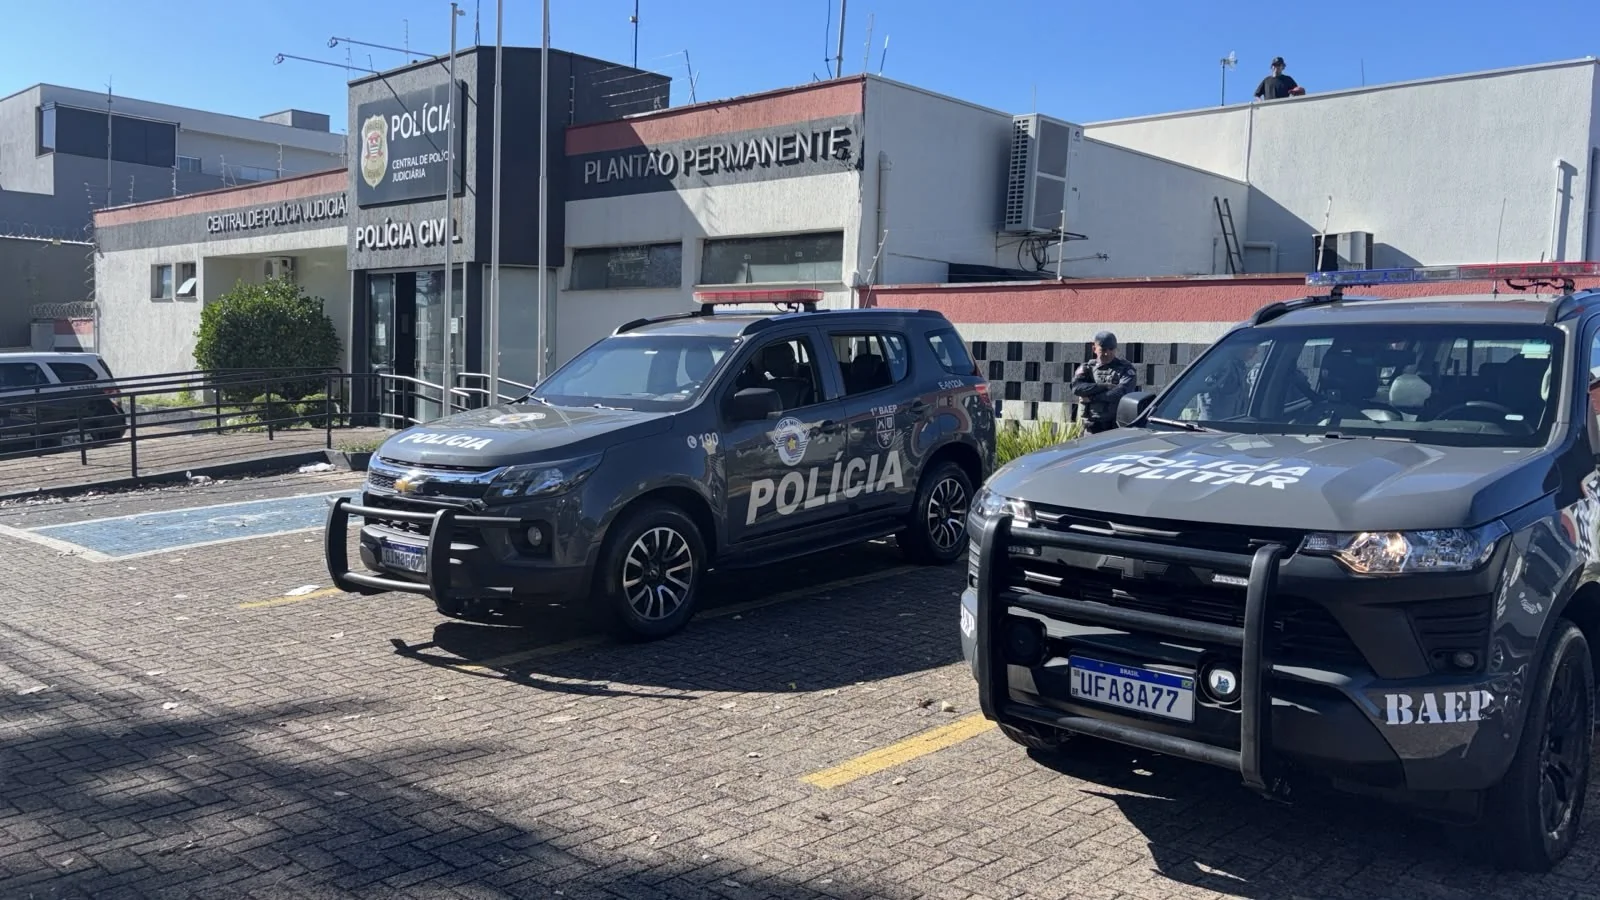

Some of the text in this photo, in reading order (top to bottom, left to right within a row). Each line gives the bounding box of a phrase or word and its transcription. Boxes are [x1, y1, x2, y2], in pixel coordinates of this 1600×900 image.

[391, 102, 456, 141] POLÍCIA
[392, 157, 419, 170] CENTRAL
[419, 154, 428, 165] DE
[680, 126, 848, 174] PERMANENTE
[392, 167, 426, 182] JUDICIÁRIA
[206, 192, 348, 232] CENTRAL DE POLÍCIA JUDICIÁ
[356, 217, 415, 249] POLÍCIA
[879, 404, 898, 415] BAEP
[699, 432, 719, 447] 190
[746, 450, 904, 526] POLÍCIA
[1079, 462, 1300, 490] MILITAR
[1120, 668, 1140, 678] BRASIL
[1081, 671, 1179, 713] UFA8A77
[1384, 690, 1495, 725] BAEP
